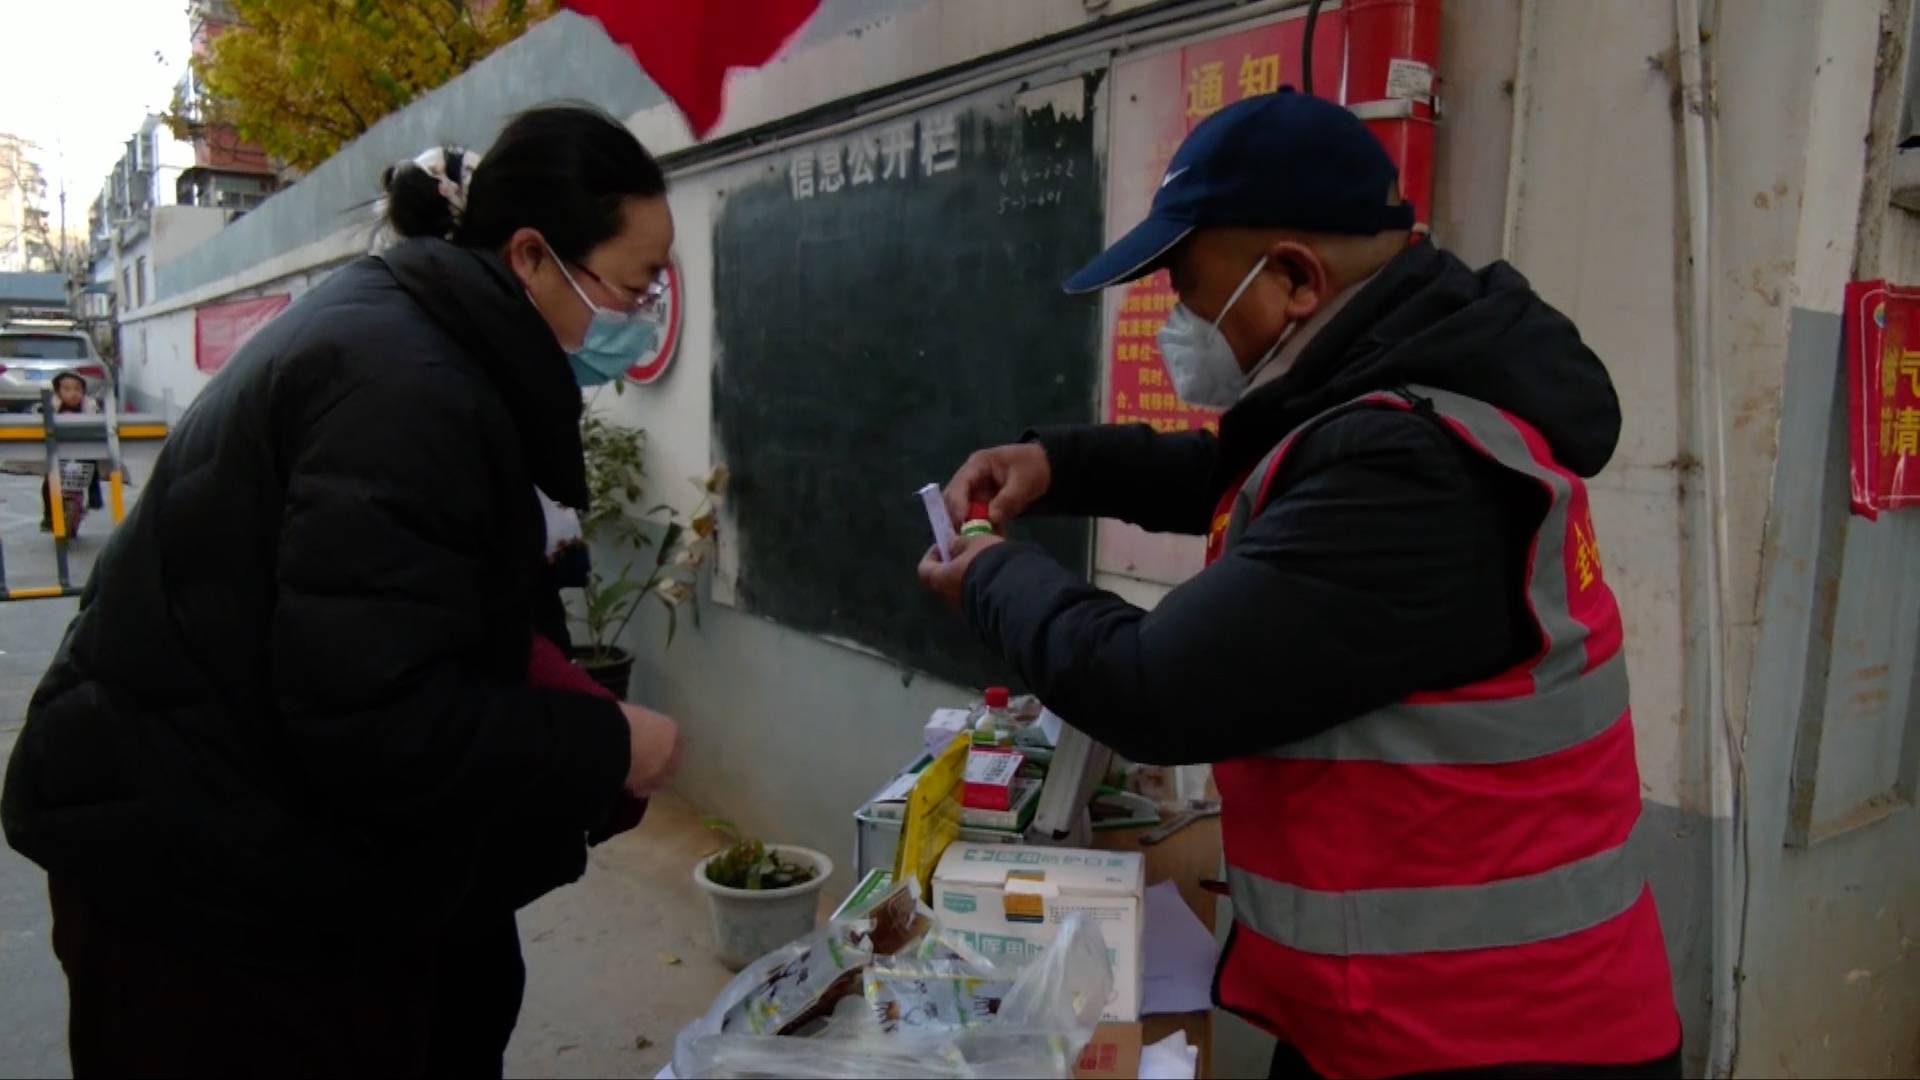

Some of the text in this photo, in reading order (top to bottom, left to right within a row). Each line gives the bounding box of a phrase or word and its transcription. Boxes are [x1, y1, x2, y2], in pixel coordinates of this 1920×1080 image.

[1186, 53, 1281, 118] 通知
[789, 112, 958, 200] 信息公开栏
